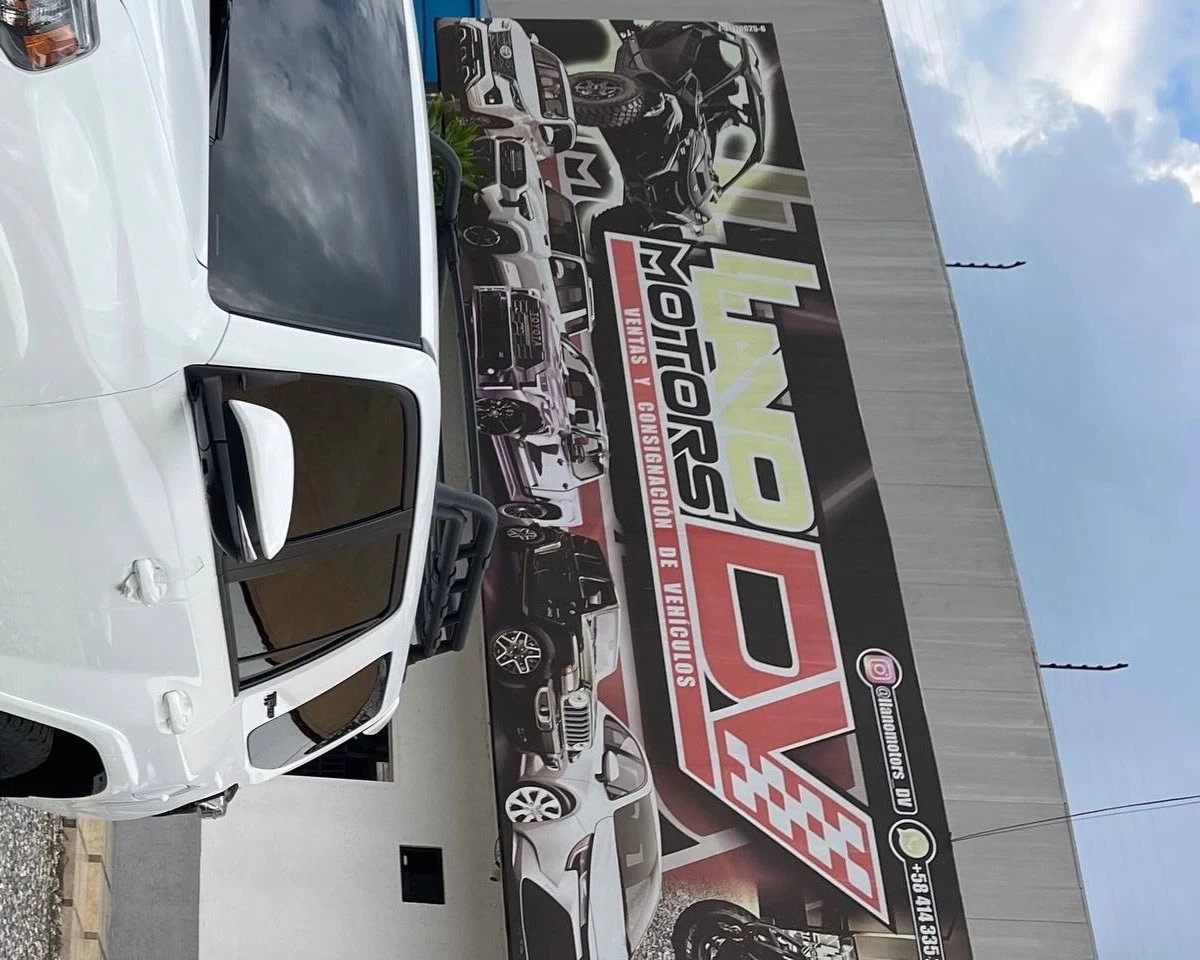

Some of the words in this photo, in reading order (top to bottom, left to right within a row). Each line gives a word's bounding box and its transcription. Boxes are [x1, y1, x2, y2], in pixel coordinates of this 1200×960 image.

[530, 312, 542, 347] TOYOTA
[623, 307, 648, 365] VENTAS
[634, 377, 651, 386] Y
[639, 241, 729, 517] MOTORS
[636, 401, 675, 529] CONSIGNACIÓN
[658, 547, 678, 569] DE
[663, 583, 696, 688] VEHÍCULOS
[686, 524, 888, 924] DV
[910, 864, 930, 893] +58
[915, 896, 935, 922] 414
[919, 925, 940, 955] 335
